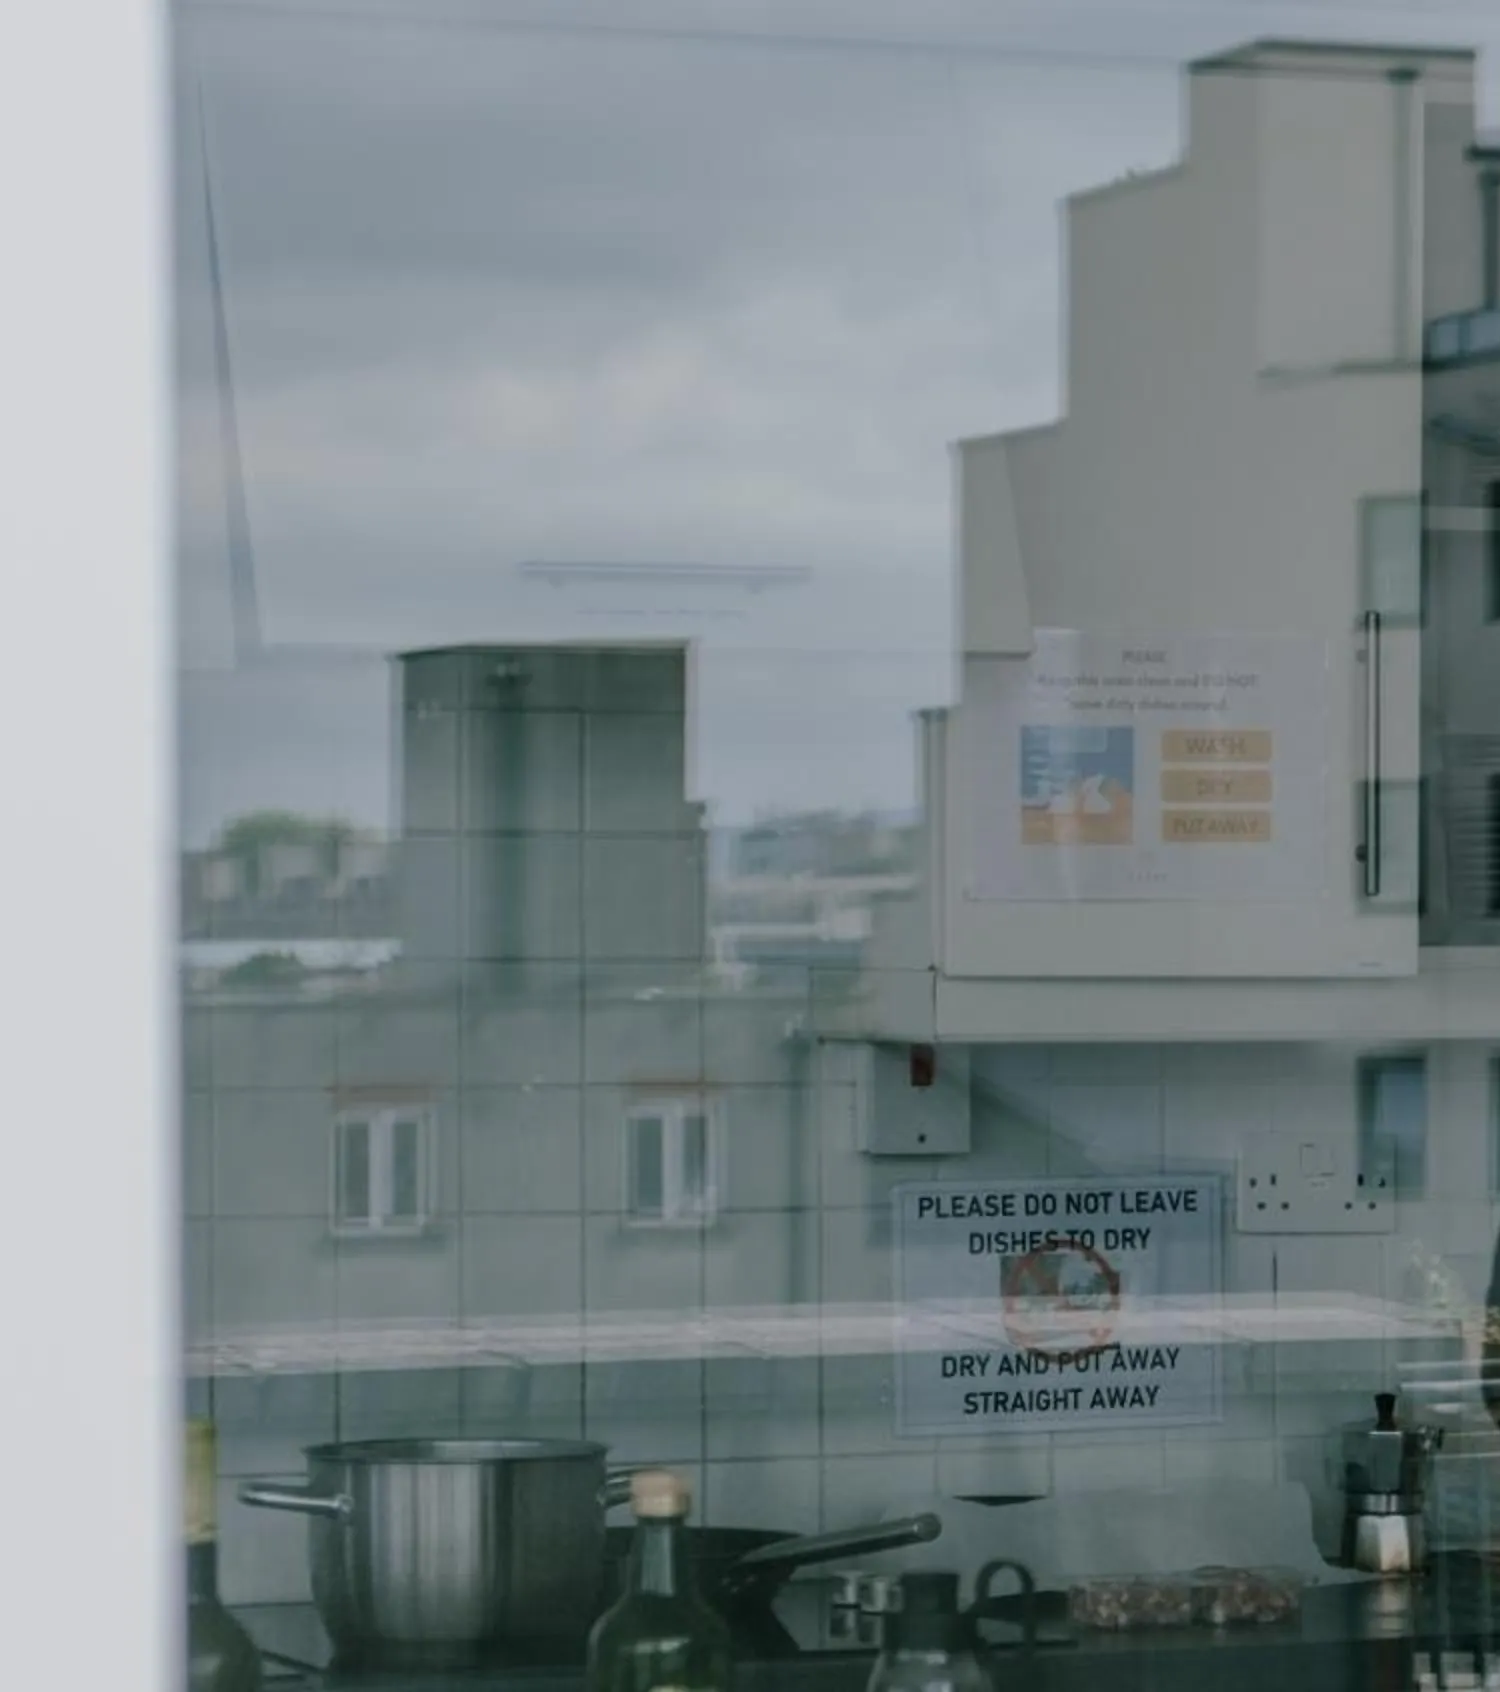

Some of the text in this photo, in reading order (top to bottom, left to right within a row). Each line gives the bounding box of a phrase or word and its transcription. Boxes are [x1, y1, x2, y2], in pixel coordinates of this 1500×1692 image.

[1184, 737, 1246, 755] WASH
[1208, 818, 1260, 834] AWAY
[918, 1189, 1199, 1219] PLEASE DO NOT LEAVE
[968, 1227, 1151, 1255] DISHES TO DRY
[941, 1347, 1181, 1379] DRY AND PUT AWAY
[963, 1385, 1161, 1415] STRAIGHT AWAY
